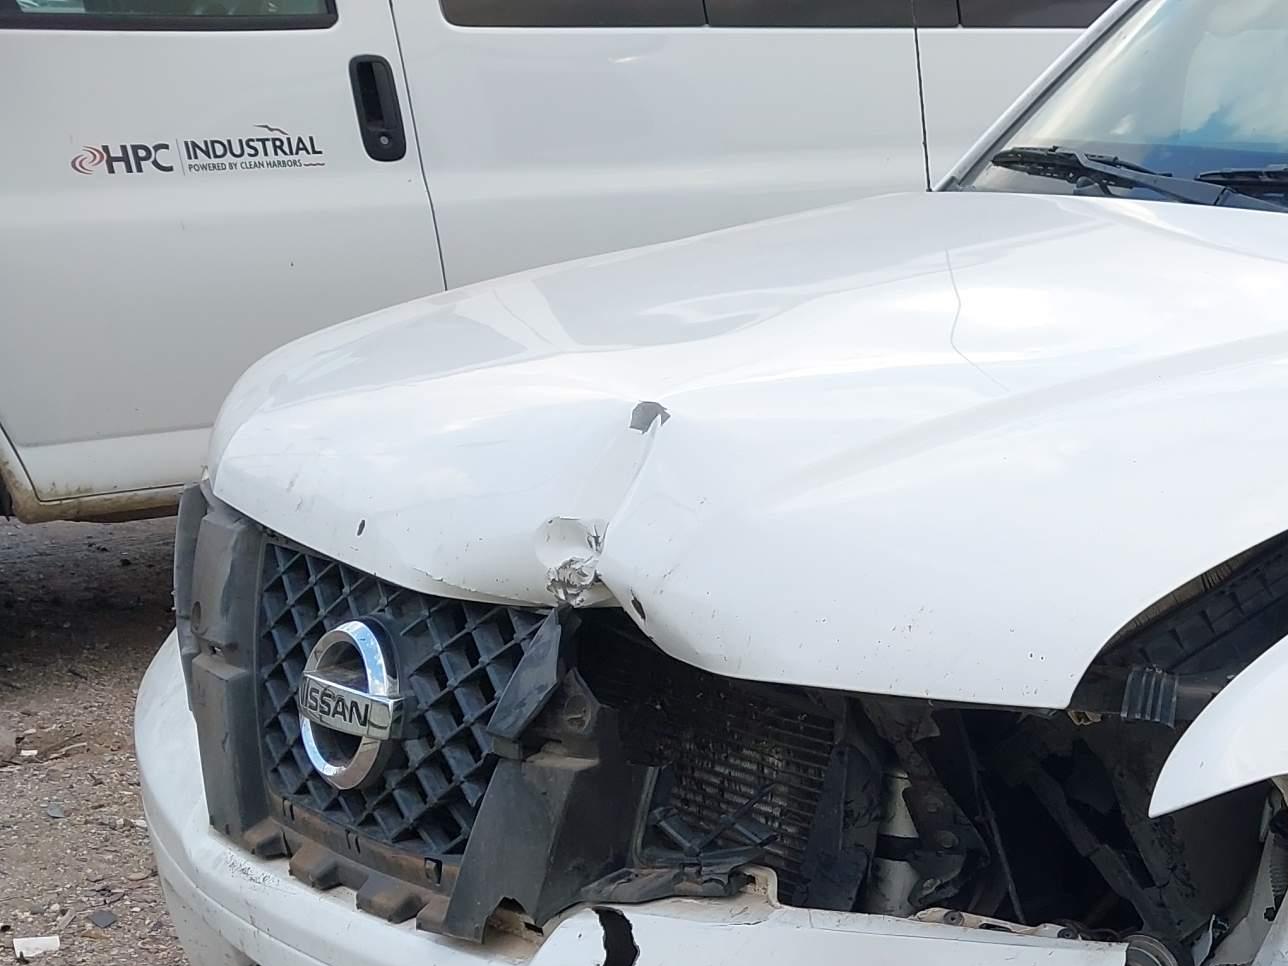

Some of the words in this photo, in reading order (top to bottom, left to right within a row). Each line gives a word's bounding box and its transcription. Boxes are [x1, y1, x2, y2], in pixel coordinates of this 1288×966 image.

[101, 143, 174, 174] HPC
[183, 136, 323, 160] INDUSTRIAL
[188, 161, 226, 172] POWERED
[228, 161, 238, 171] BY
[240, 160, 265, 170] CLEAN
[266, 159, 303, 169] HARBORS
[301, 677, 369, 727] NISSAN
